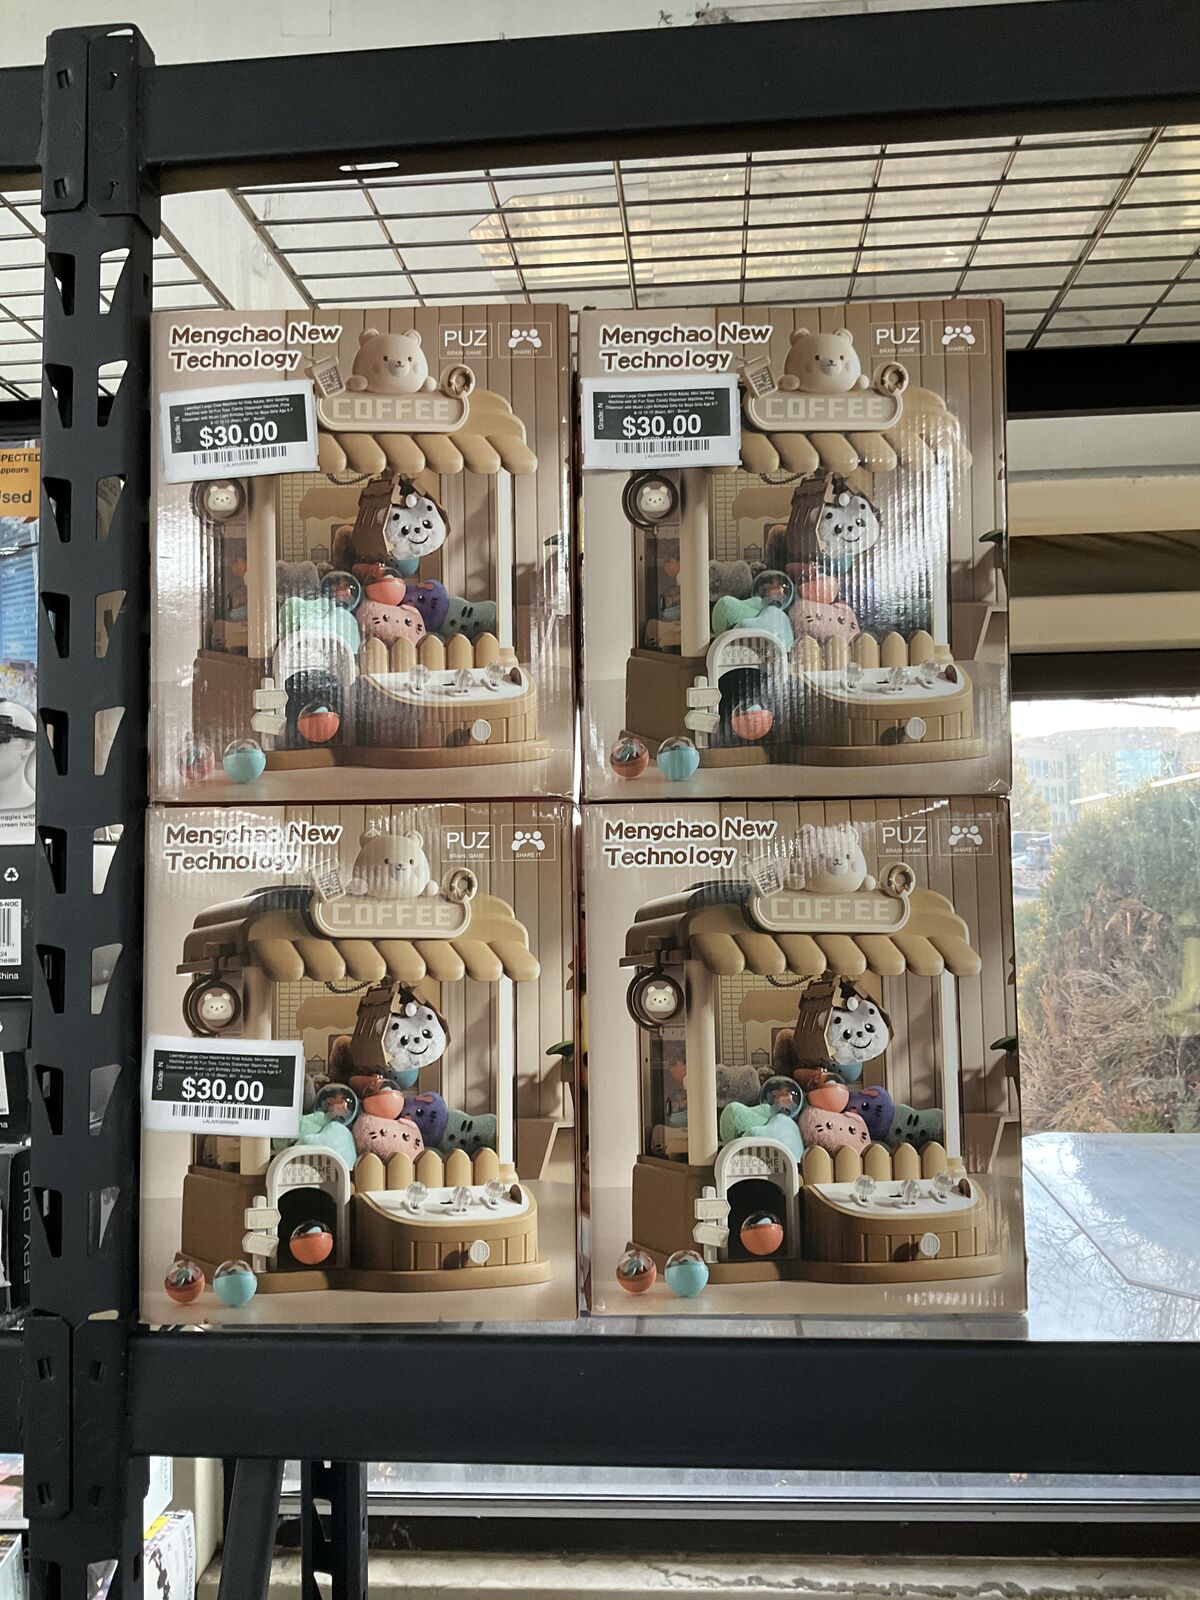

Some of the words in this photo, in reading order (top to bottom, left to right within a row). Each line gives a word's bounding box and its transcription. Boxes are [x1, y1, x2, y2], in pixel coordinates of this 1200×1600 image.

[171, 326, 283, 345] Mengchao
[289, 324, 340, 341] New
[444, 330, 487, 347] PUZ
[601, 326, 713, 345] Mengchao
[720, 324, 770, 341] New
[876, 328, 920, 345] PUZ
[171, 350, 299, 369] Technology
[601, 350, 730, 370] Technology
[332, 398, 449, 419] COFFEE
[765, 398, 882, 419] COFFEE
[200, 421, 278, 449] $30.00
[622, 415, 702, 438] $30.00
[0, 453, 41, 462] PECTED
[0, 467, 28, 475] ppears
[0, 490, 32, 504] sed
[166, 825, 281, 845] Mengchao
[288, 824, 340, 843] New
[605, 821, 717, 841] Mengchao
[724, 819, 775, 838] New
[882, 827, 926, 844] PUZ
[447, 832, 490, 849] PUZ
[165, 851, 298, 871] Technology
[604, 846, 735, 866] Technology
[332, 903, 451, 926] COFFEE
[770, 898, 890, 920] COFFEE
[182, 1076, 263, 1102] $30.00
[730, 1158, 780, 1168] WELCOME
